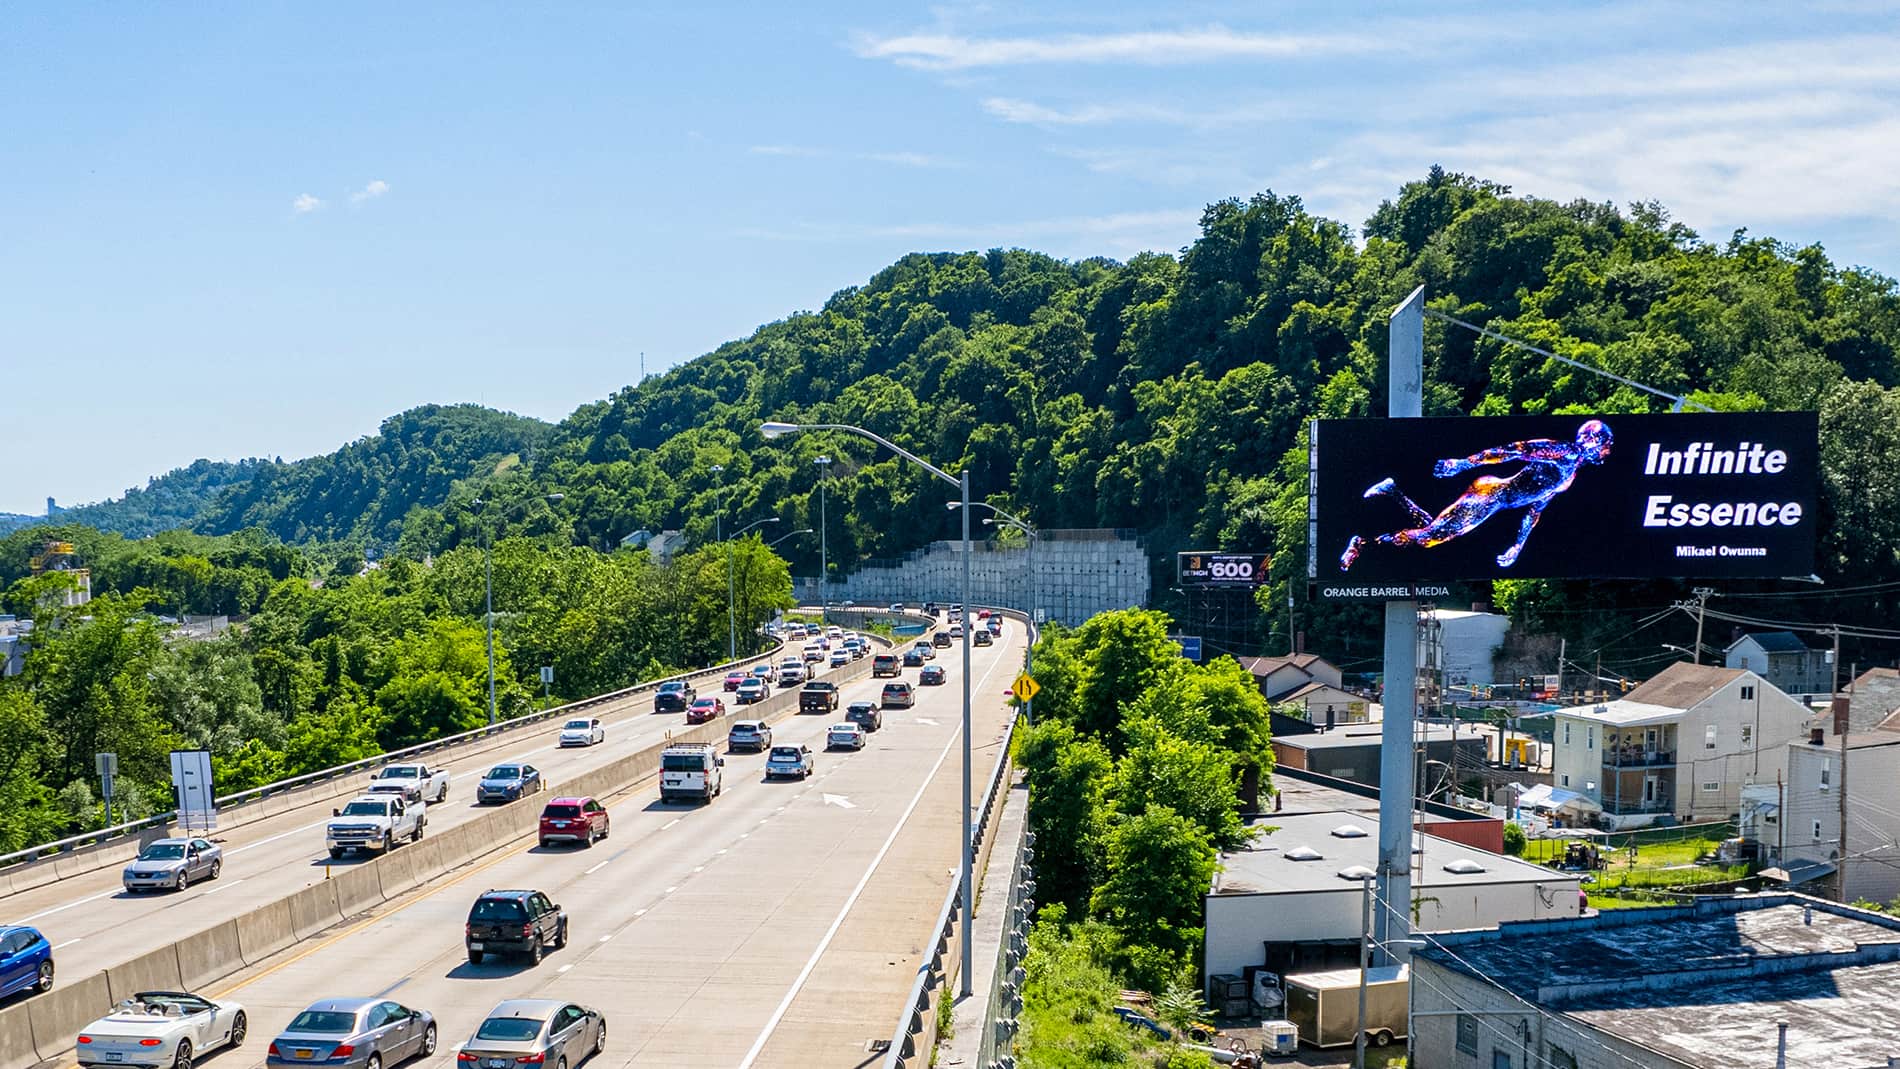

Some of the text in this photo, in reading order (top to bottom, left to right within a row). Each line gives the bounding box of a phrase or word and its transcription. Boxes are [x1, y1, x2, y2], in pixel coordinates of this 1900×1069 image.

[1644, 441, 1787, 475] Infinite
[1643, 494, 1802, 528] Essence
[1675, 545, 1767, 557] Mikael Owunna
[1207, 562, 1253, 577] $600
[1323, 586, 1450, 597] ORANGE BARREL MEDIA
